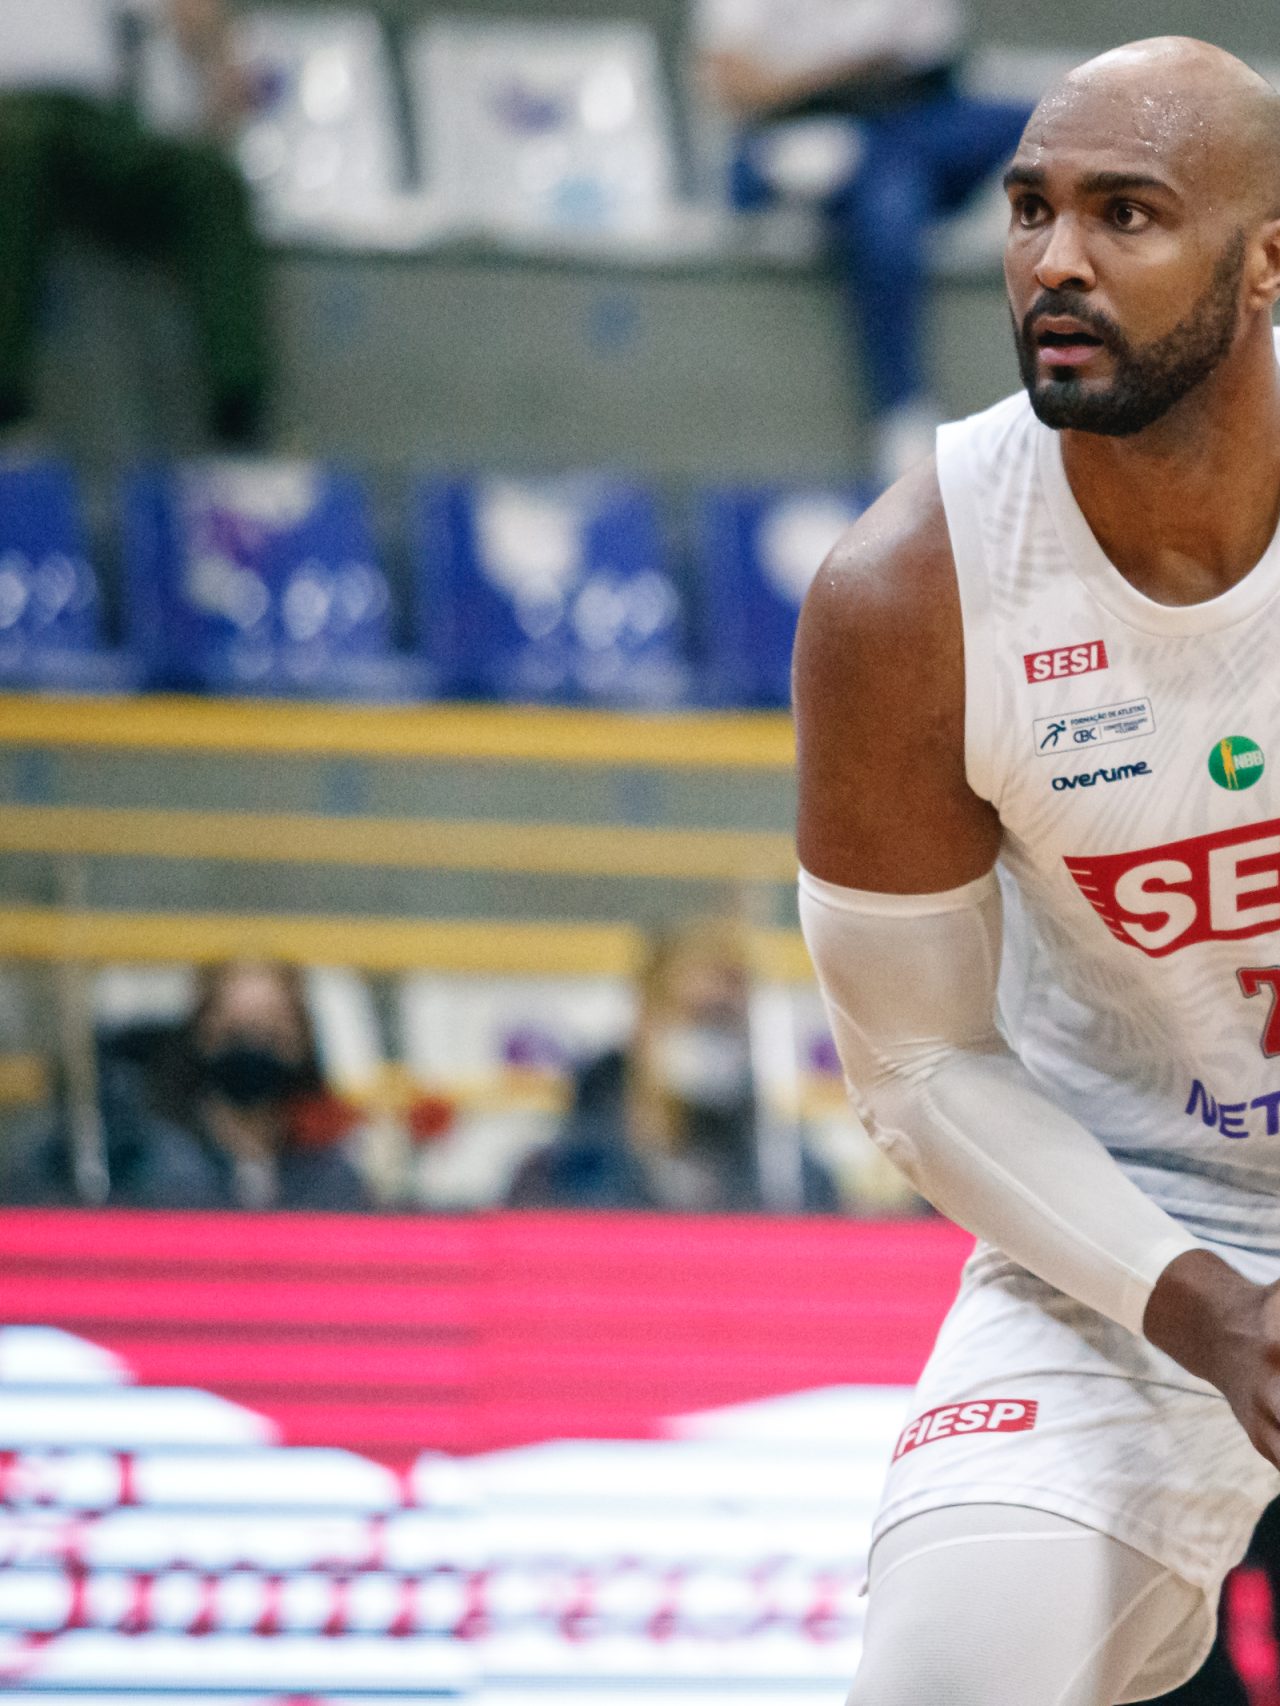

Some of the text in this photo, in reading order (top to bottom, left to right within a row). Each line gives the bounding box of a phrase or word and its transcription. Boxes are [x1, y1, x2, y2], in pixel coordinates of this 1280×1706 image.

[1032, 644, 1099, 680] SESI
[1052, 761, 1152, 791] overtime
[1233, 750, 1264, 770] NBB
[896, 1402, 1026, 1456] FIESP
